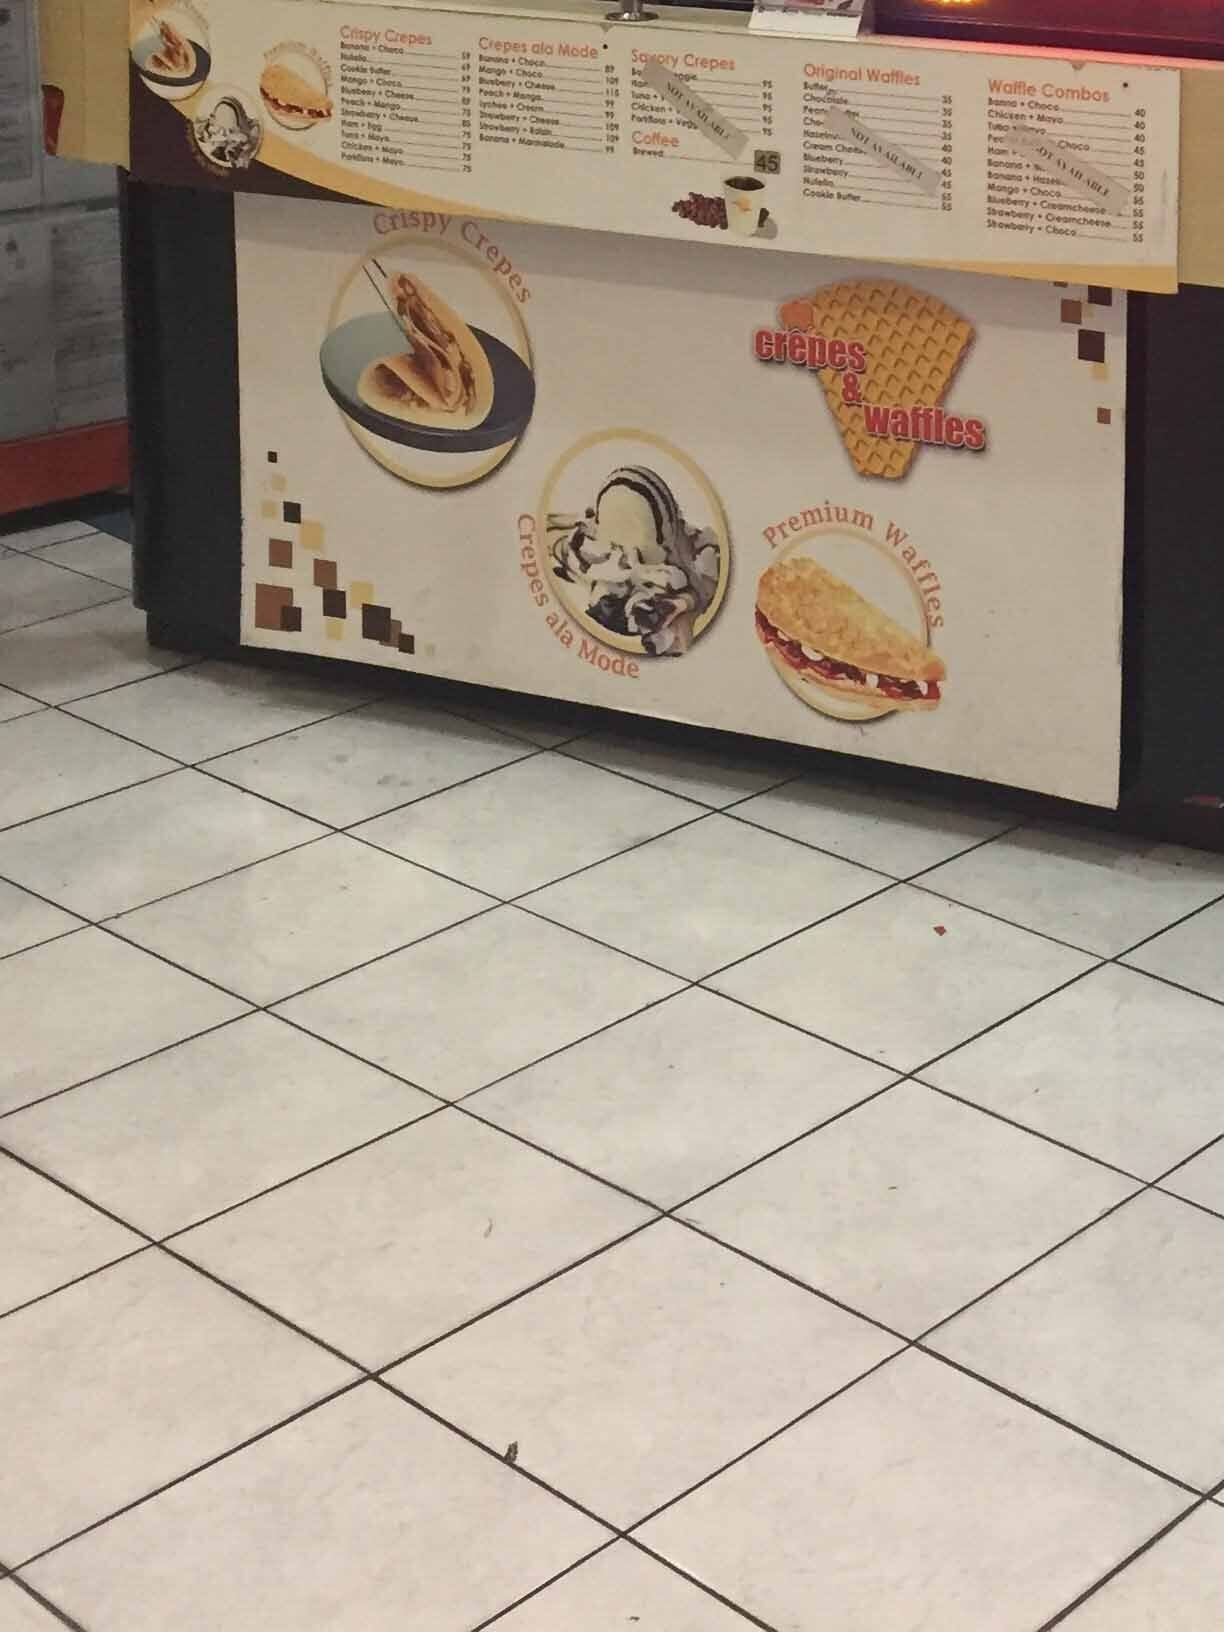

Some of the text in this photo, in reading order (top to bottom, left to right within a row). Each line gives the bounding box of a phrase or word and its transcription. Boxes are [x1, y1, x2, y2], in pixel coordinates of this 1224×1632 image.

[340, 25, 432, 45] Crispy Crepes
[479, 37, 598, 59] Crepes ala Mode
[631, 49, 737, 71] Savory Crepes
[803, 63, 921, 86] Original Waffles
[988, 79, 1112, 103] Waffle Combos
[988, 109, 1027, 121] Chicken
[1036, 113, 1064, 125] Mayo
[1027, 100, 1060, 112] Choco
[631, 130, 680, 148] Coffee
[1056, 140, 1090, 151] Choco
[756, 154, 779, 173] 45
[987, 183, 1020, 196] Mango
[1030, 187, 1062, 198] Choco
[1045, 224, 1077, 237] Choco
[371, 209, 533, 306] Crispy Crepes
[753, 327, 867, 371] crepes
[841, 371, 863, 403] &
[862, 402, 986, 450] waffles
[762, 500, 944, 630] Premium Waffles
[516, 513, 641, 679] Crepes ala Mode
